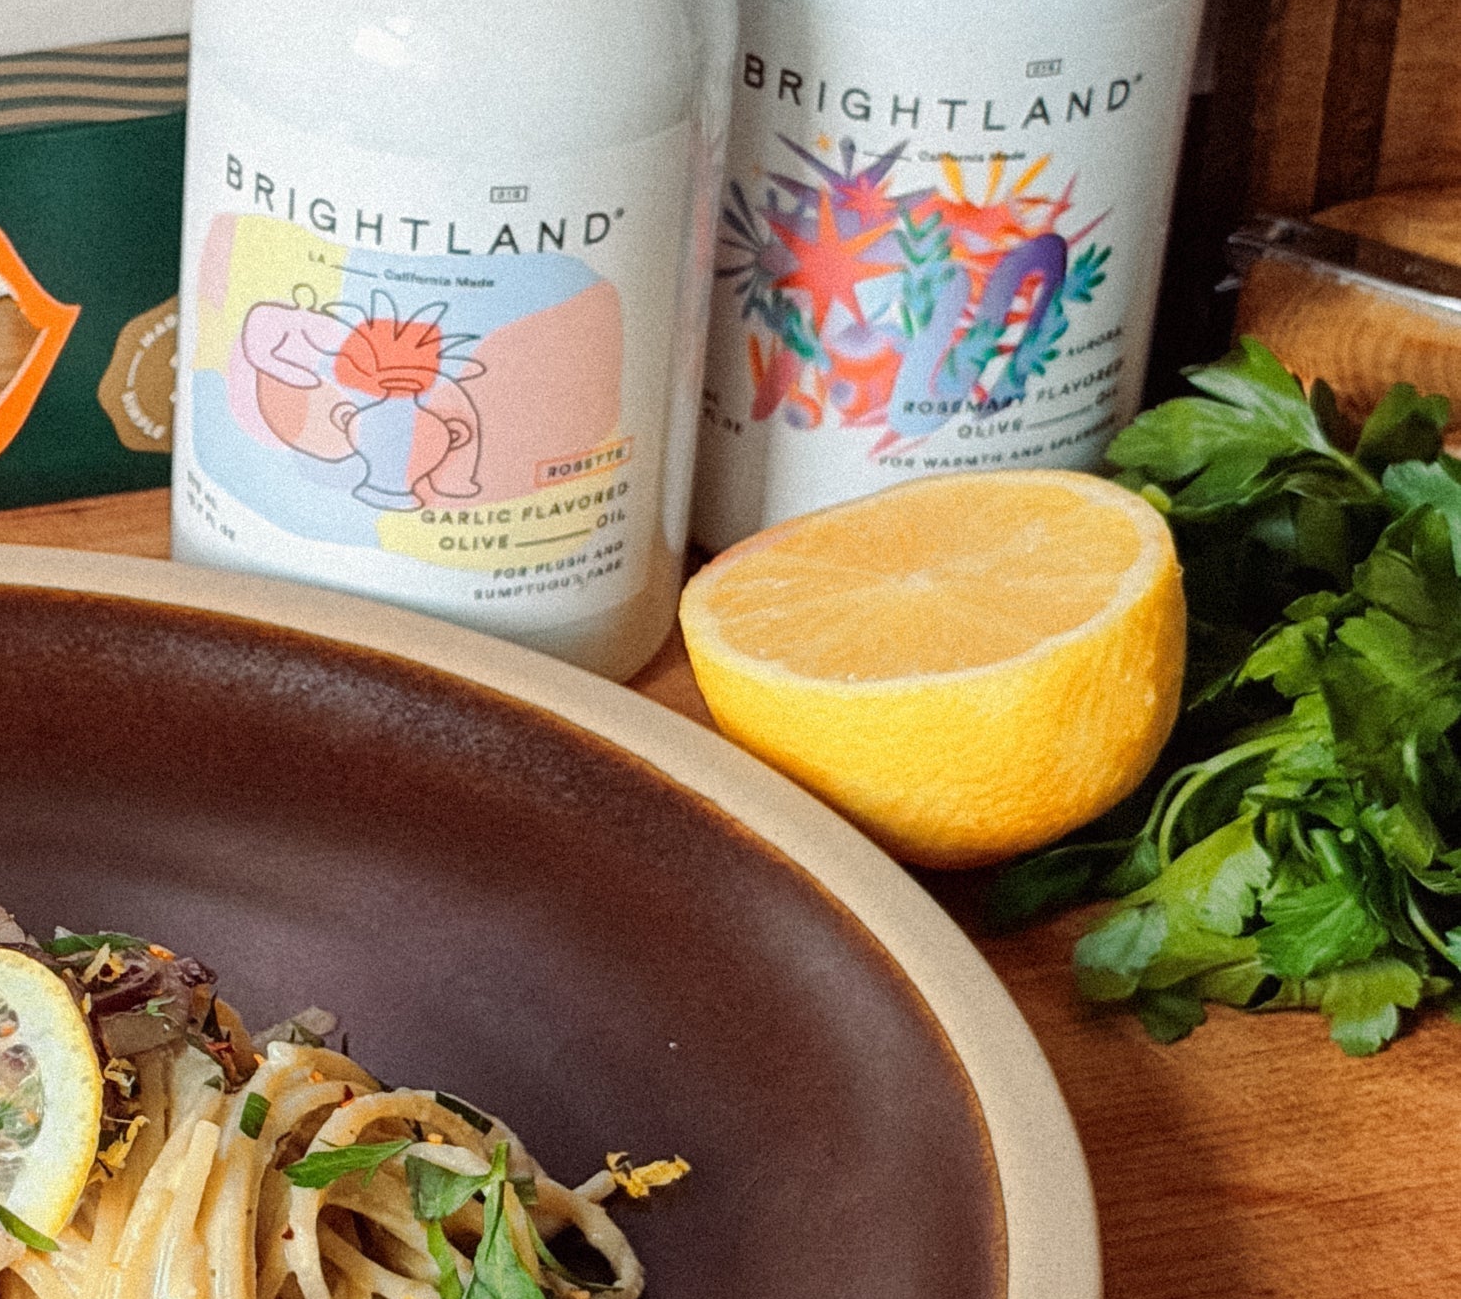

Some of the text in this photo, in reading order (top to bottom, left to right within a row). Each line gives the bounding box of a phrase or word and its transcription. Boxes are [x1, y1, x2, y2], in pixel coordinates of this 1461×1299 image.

[742, 51, 1136, 132] BRIGHTLAND
[226, 153, 614, 257] BRIGHTLAND
[383, 268, 496, 289] California Made
[957, 418, 1024, 440] OLIVE
[546, 448, 625, 479] ROSETTE
[923, 451, 1003, 470] WARMTH
[1010, 446, 1044, 461] AND
[420, 480, 630, 526] GARLIC FLAVORED
[438, 507, 627, 552] OLIVE OIL
[493, 539, 625, 580] FOR PLUSH AND
